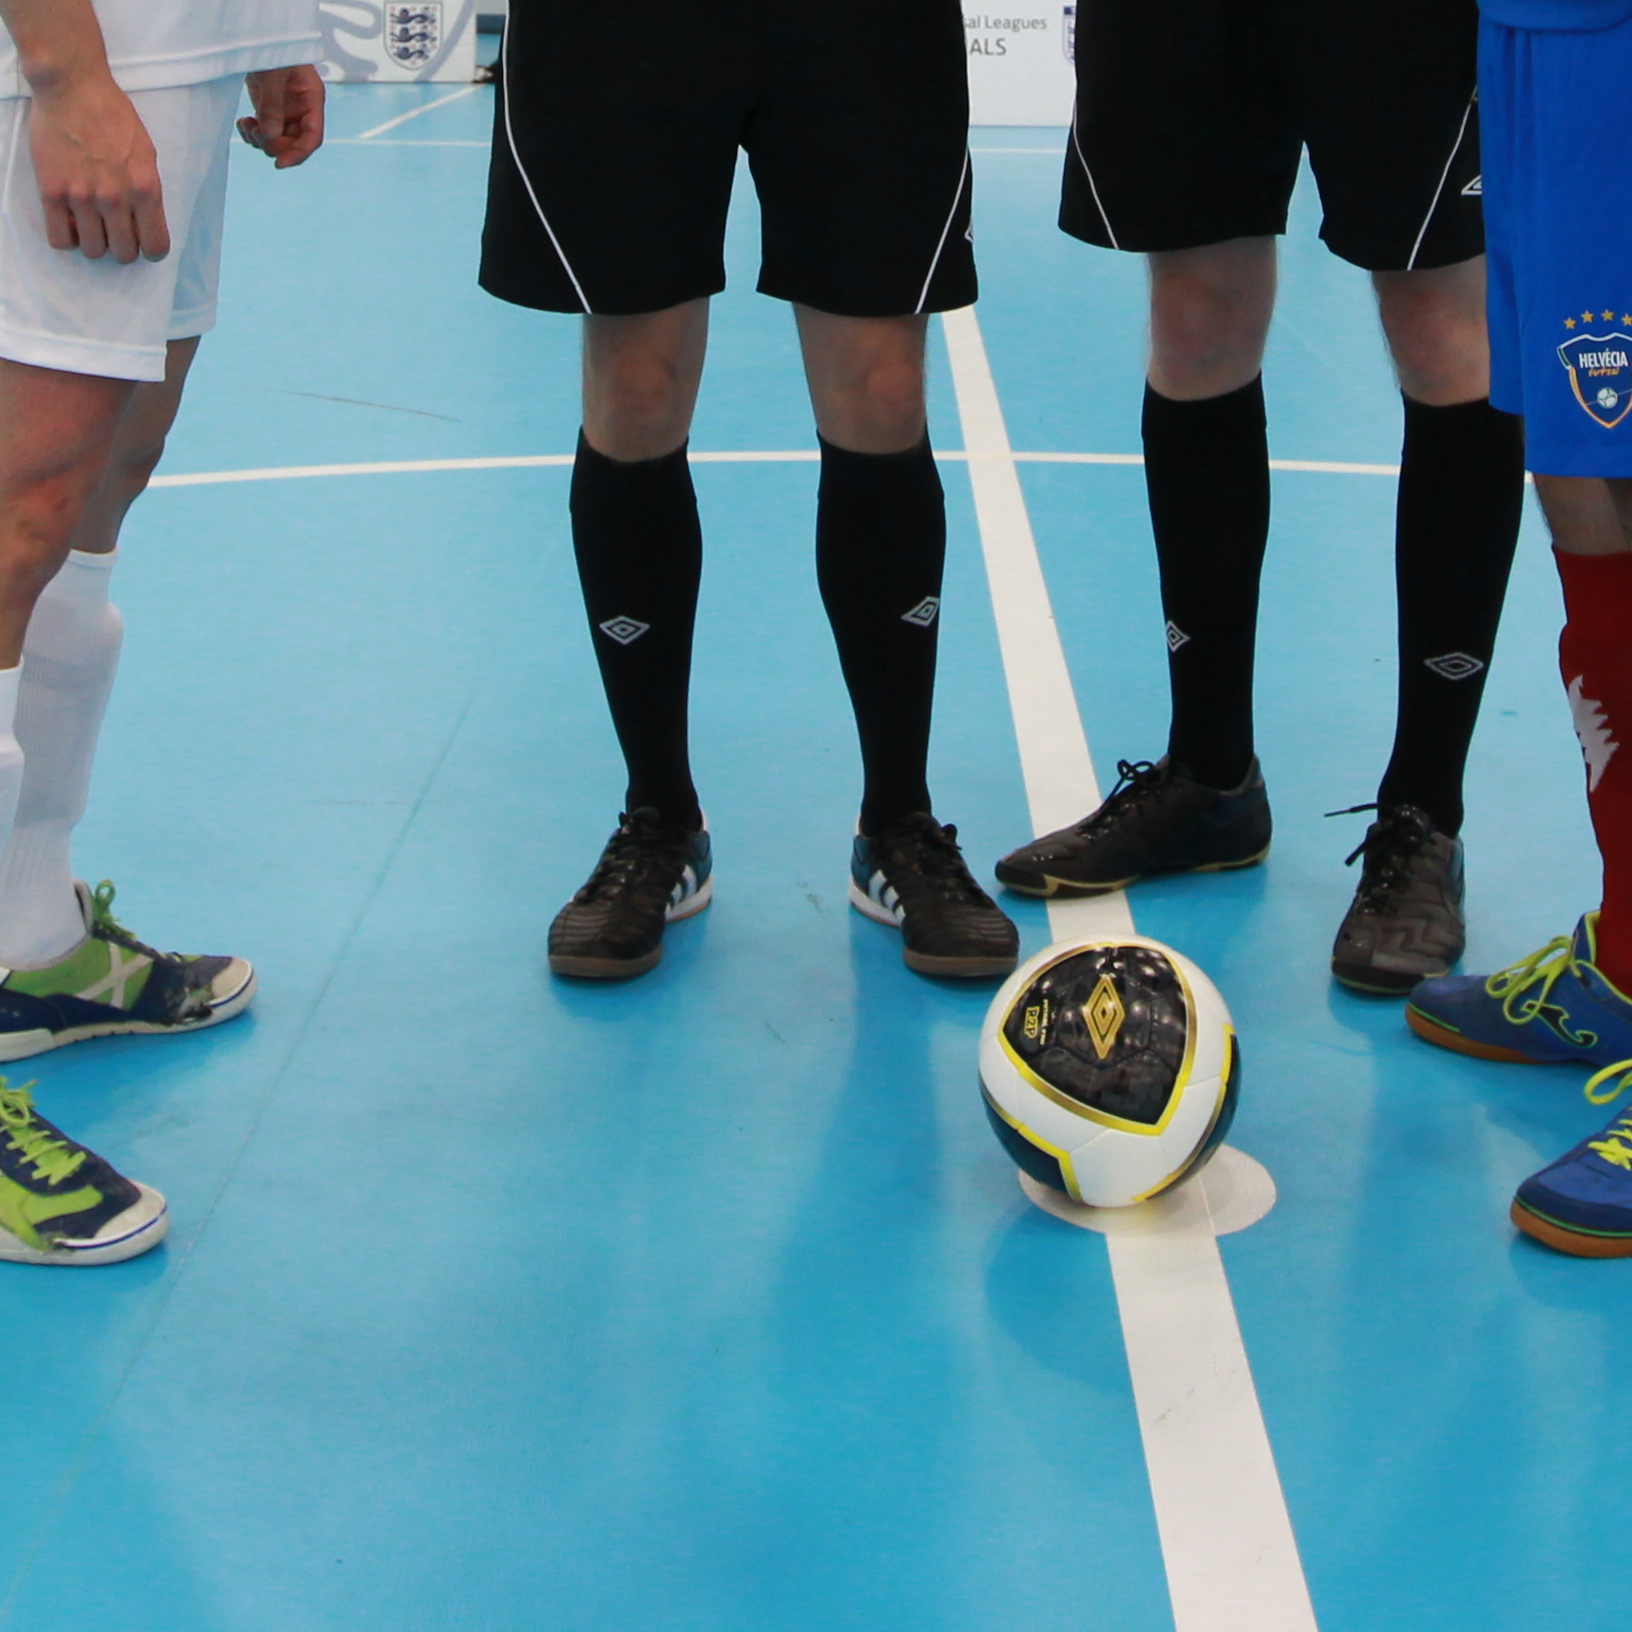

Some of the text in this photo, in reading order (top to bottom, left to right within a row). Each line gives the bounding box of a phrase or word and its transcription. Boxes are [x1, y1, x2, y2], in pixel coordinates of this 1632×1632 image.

[984, 15, 1048, 33] Leagues
[970, 37, 1007, 56] ALS
[1579, 348, 1628, 368] HELVÉCIA
